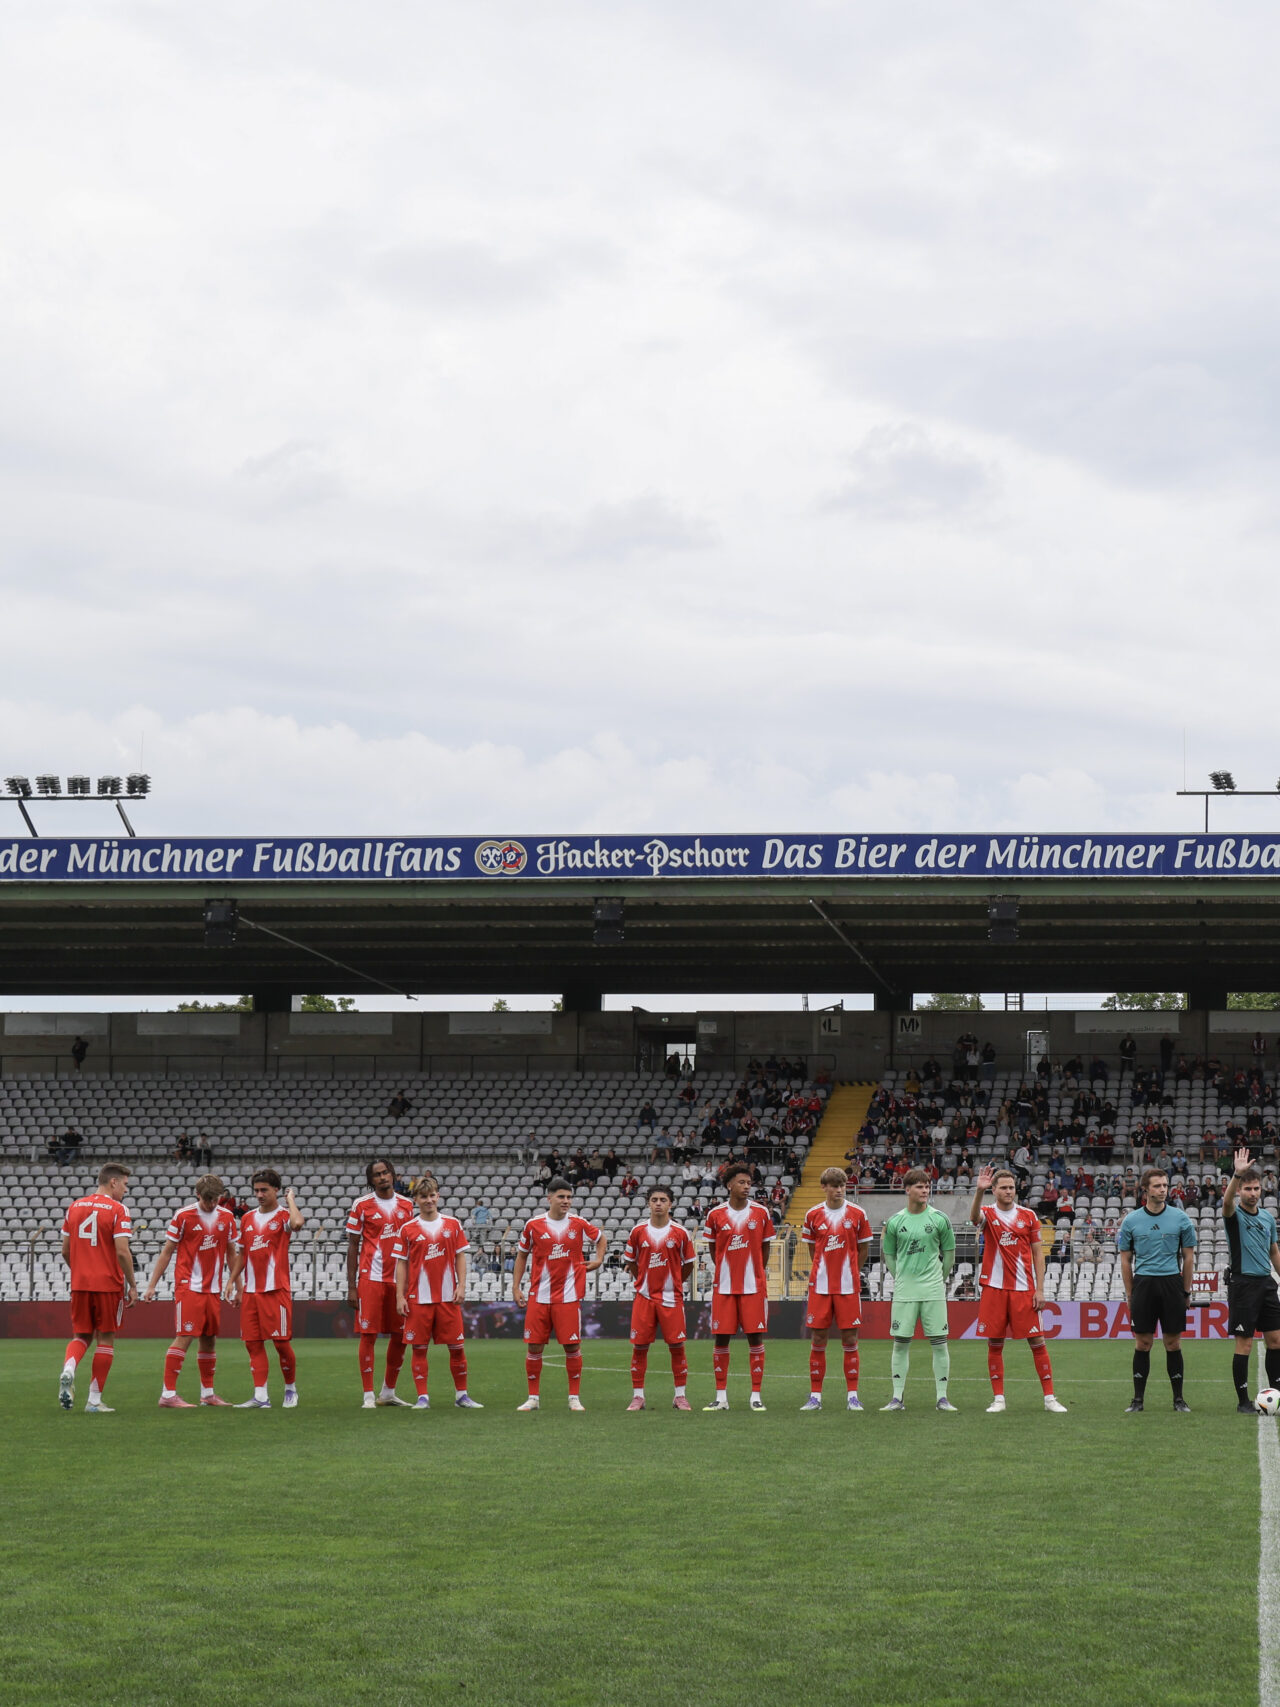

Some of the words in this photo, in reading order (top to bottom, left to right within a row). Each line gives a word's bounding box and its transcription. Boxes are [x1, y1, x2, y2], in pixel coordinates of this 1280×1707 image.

[0, 844, 57, 872] der
[66, 841, 243, 873] Münchner
[252, 842, 462, 877] Fußballfans
[536, 839, 750, 876] Hacker-Pschorr
[761, 838, 823, 869] Das
[834, 836, 907, 869] Bier
[914, 839, 976, 869] der
[985, 836, 1165, 869] Münchner
[827, 1018, 839, 1033] L
[900, 1017, 915, 1033] M
[79, 1210, 99, 1247] 4
[1191, 1272, 1217, 1281] REW
